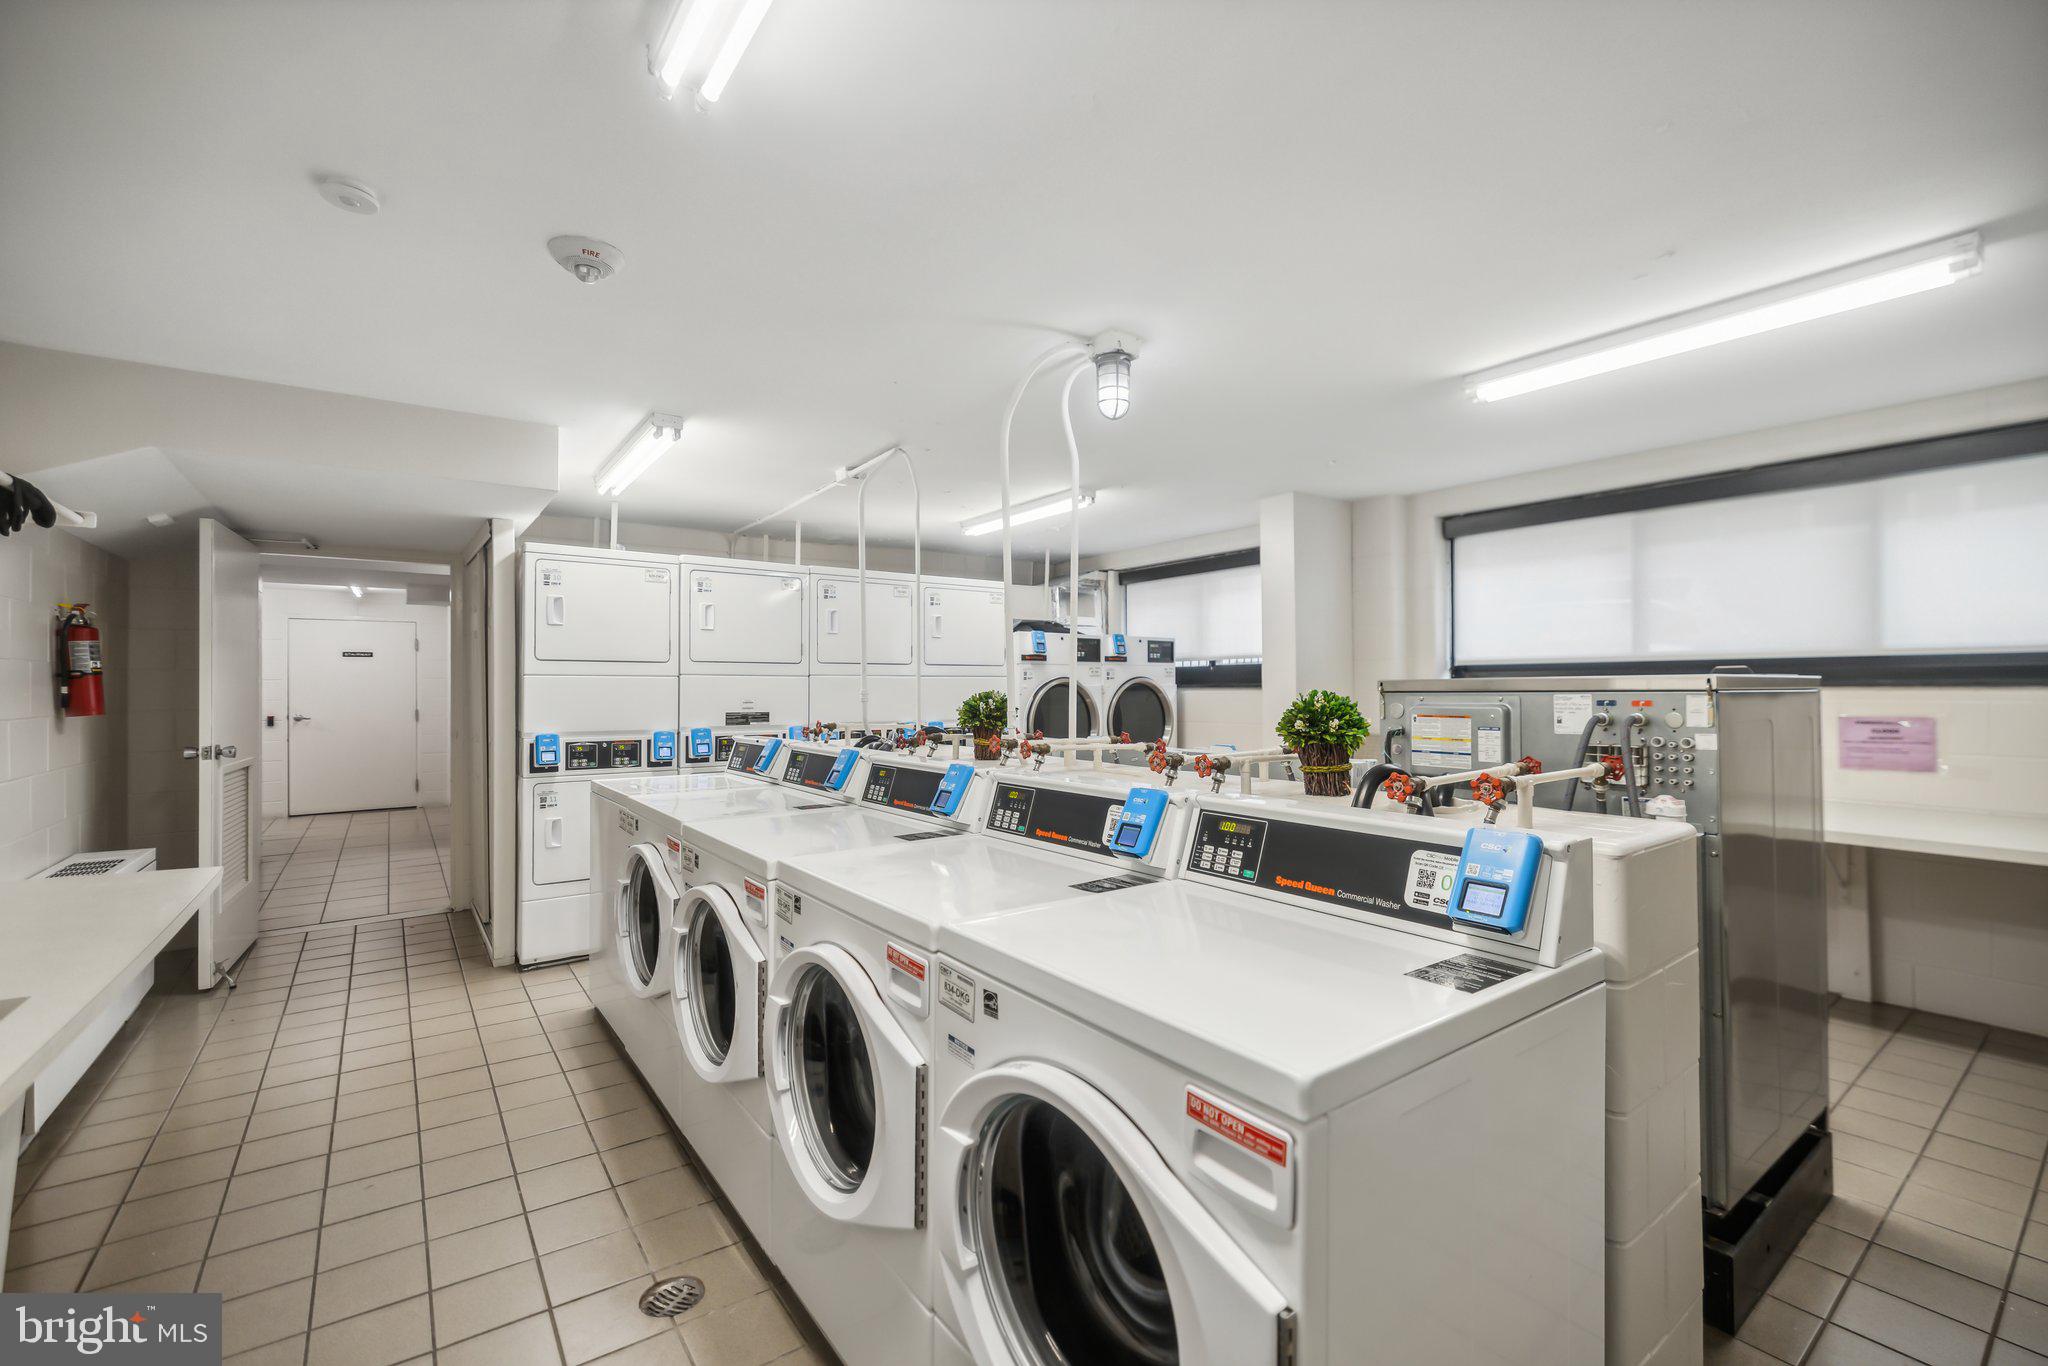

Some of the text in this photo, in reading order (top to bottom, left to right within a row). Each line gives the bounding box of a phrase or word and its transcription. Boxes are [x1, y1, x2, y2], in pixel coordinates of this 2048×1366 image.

[582, 248, 601, 259] FIRE
[1480, 842, 1501, 851] CSC
[1275, 876, 1304, 888] Speed
[1305, 882, 1335, 896] Queen
[1336, 890, 1374, 905] Commercial
[1375, 897, 1401, 910] Washer
[1203, 1103, 1219, 1121] NOT
[1221, 1113, 1245, 1135] OPEN
